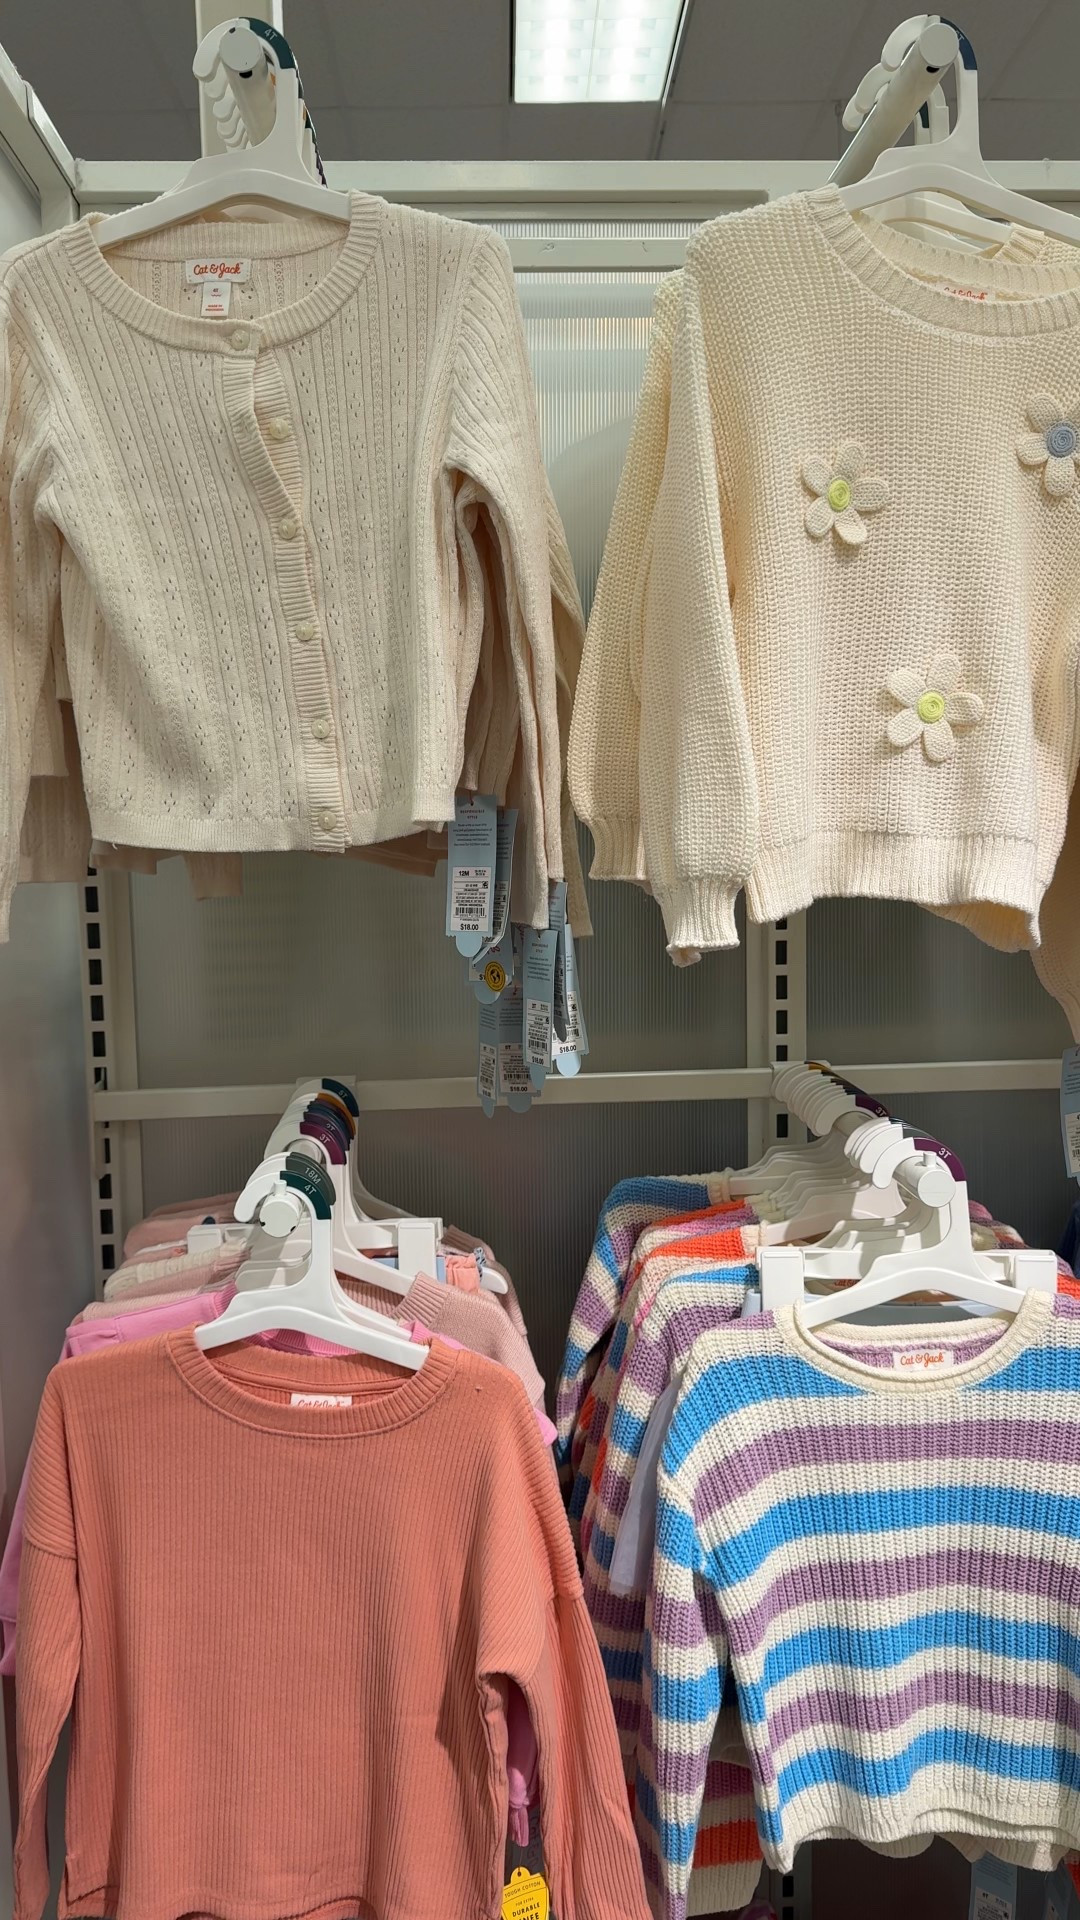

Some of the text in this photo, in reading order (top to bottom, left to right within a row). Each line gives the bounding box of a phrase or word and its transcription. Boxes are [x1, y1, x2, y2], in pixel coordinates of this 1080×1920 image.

[264, 28, 278, 40] 4T
[193, 262, 241, 278] Cat & Jack
[460, 923, 479, 931] $18.00
[559, 1044, 577, 1053] $18.00
[875, 1106, 887, 1117] 3T
[320, 1133, 331, 1144] 3T
[938, 1147, 952, 1159] 3T
[304, 1167, 322, 1184] 18M
[304, 1184, 317, 1195] 4T
[900, 1352, 944, 1368] Cat & Jack
[521, 1880, 541, 1891] COTTON
[512, 1901, 541, 1917] DURABLE
